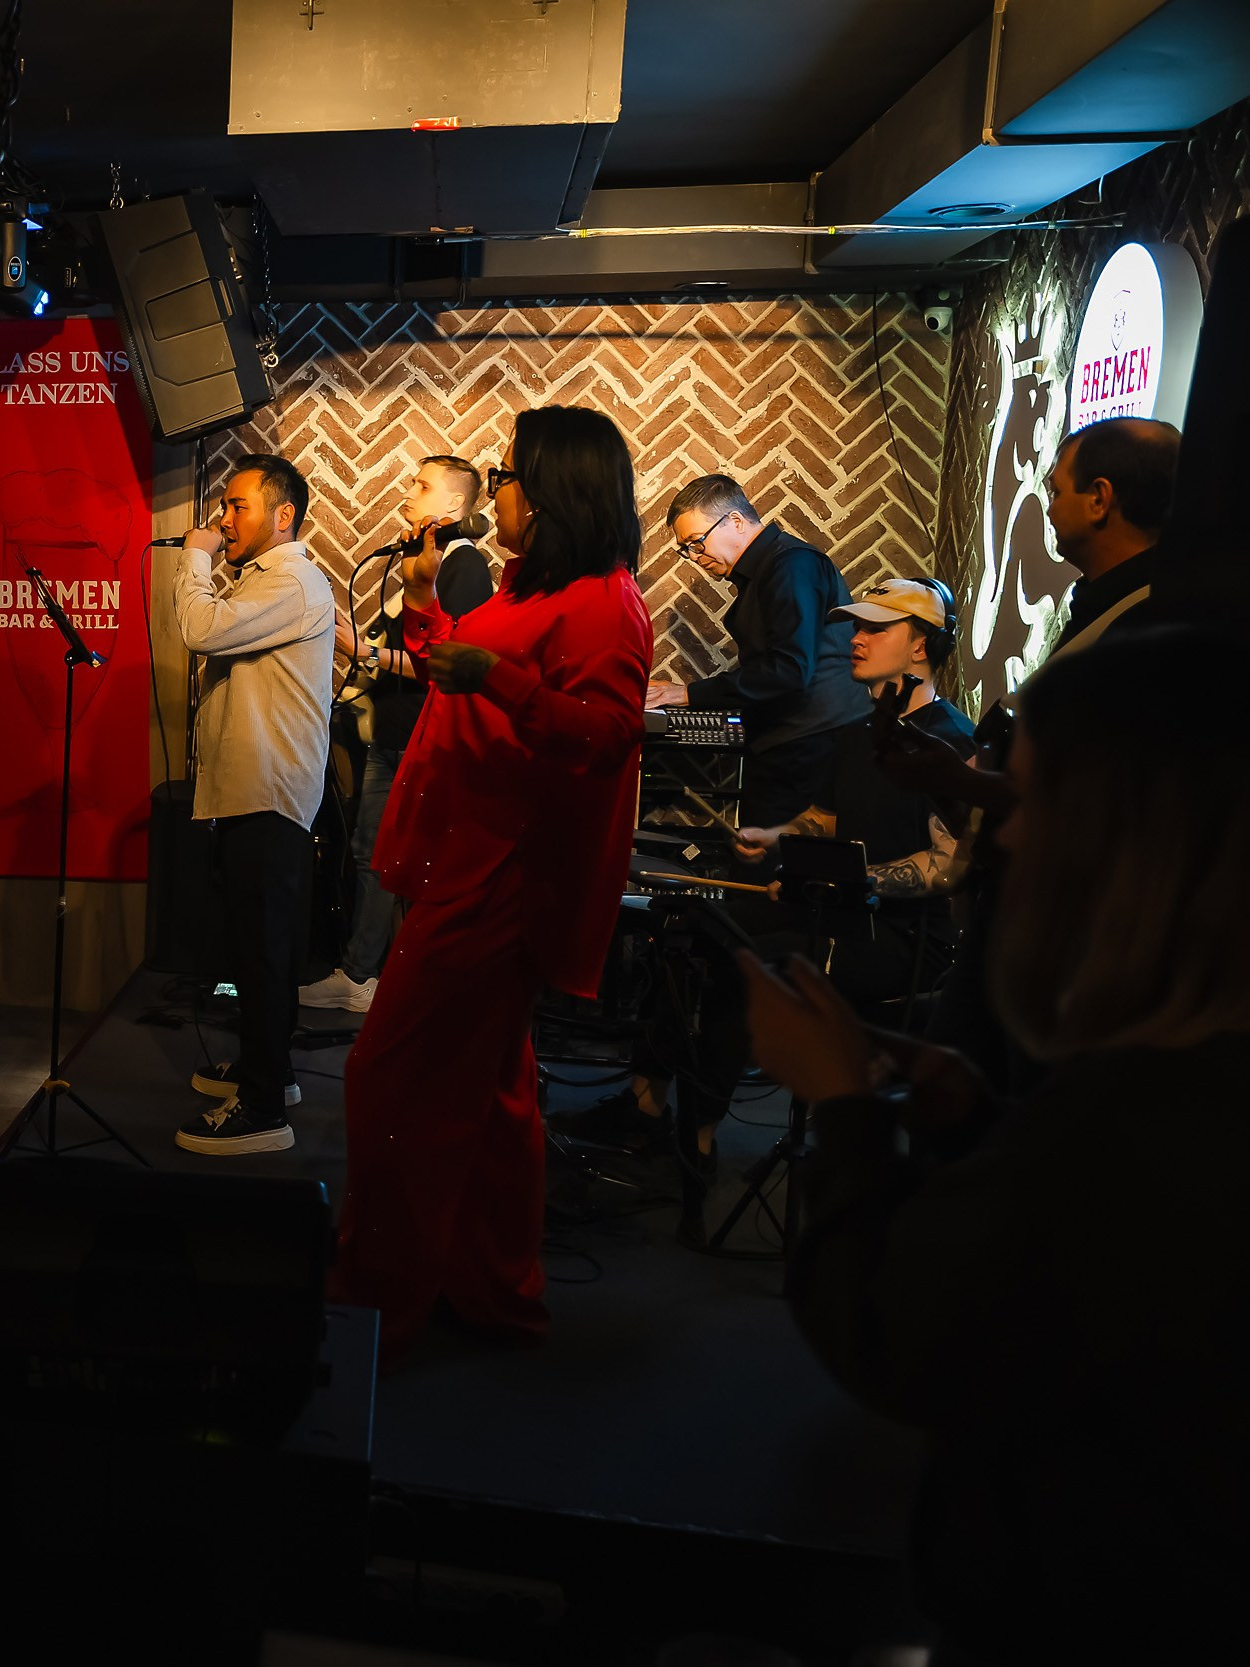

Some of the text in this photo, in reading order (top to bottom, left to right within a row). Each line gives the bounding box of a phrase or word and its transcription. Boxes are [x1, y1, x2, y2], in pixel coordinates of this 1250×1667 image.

[69, 350, 130, 373] UNS
[1080, 346, 1151, 404] BREMEN
[0, 382, 118, 405] TANZEN
[39, 614, 55, 629] &
[65, 614, 120, 630] RILL
